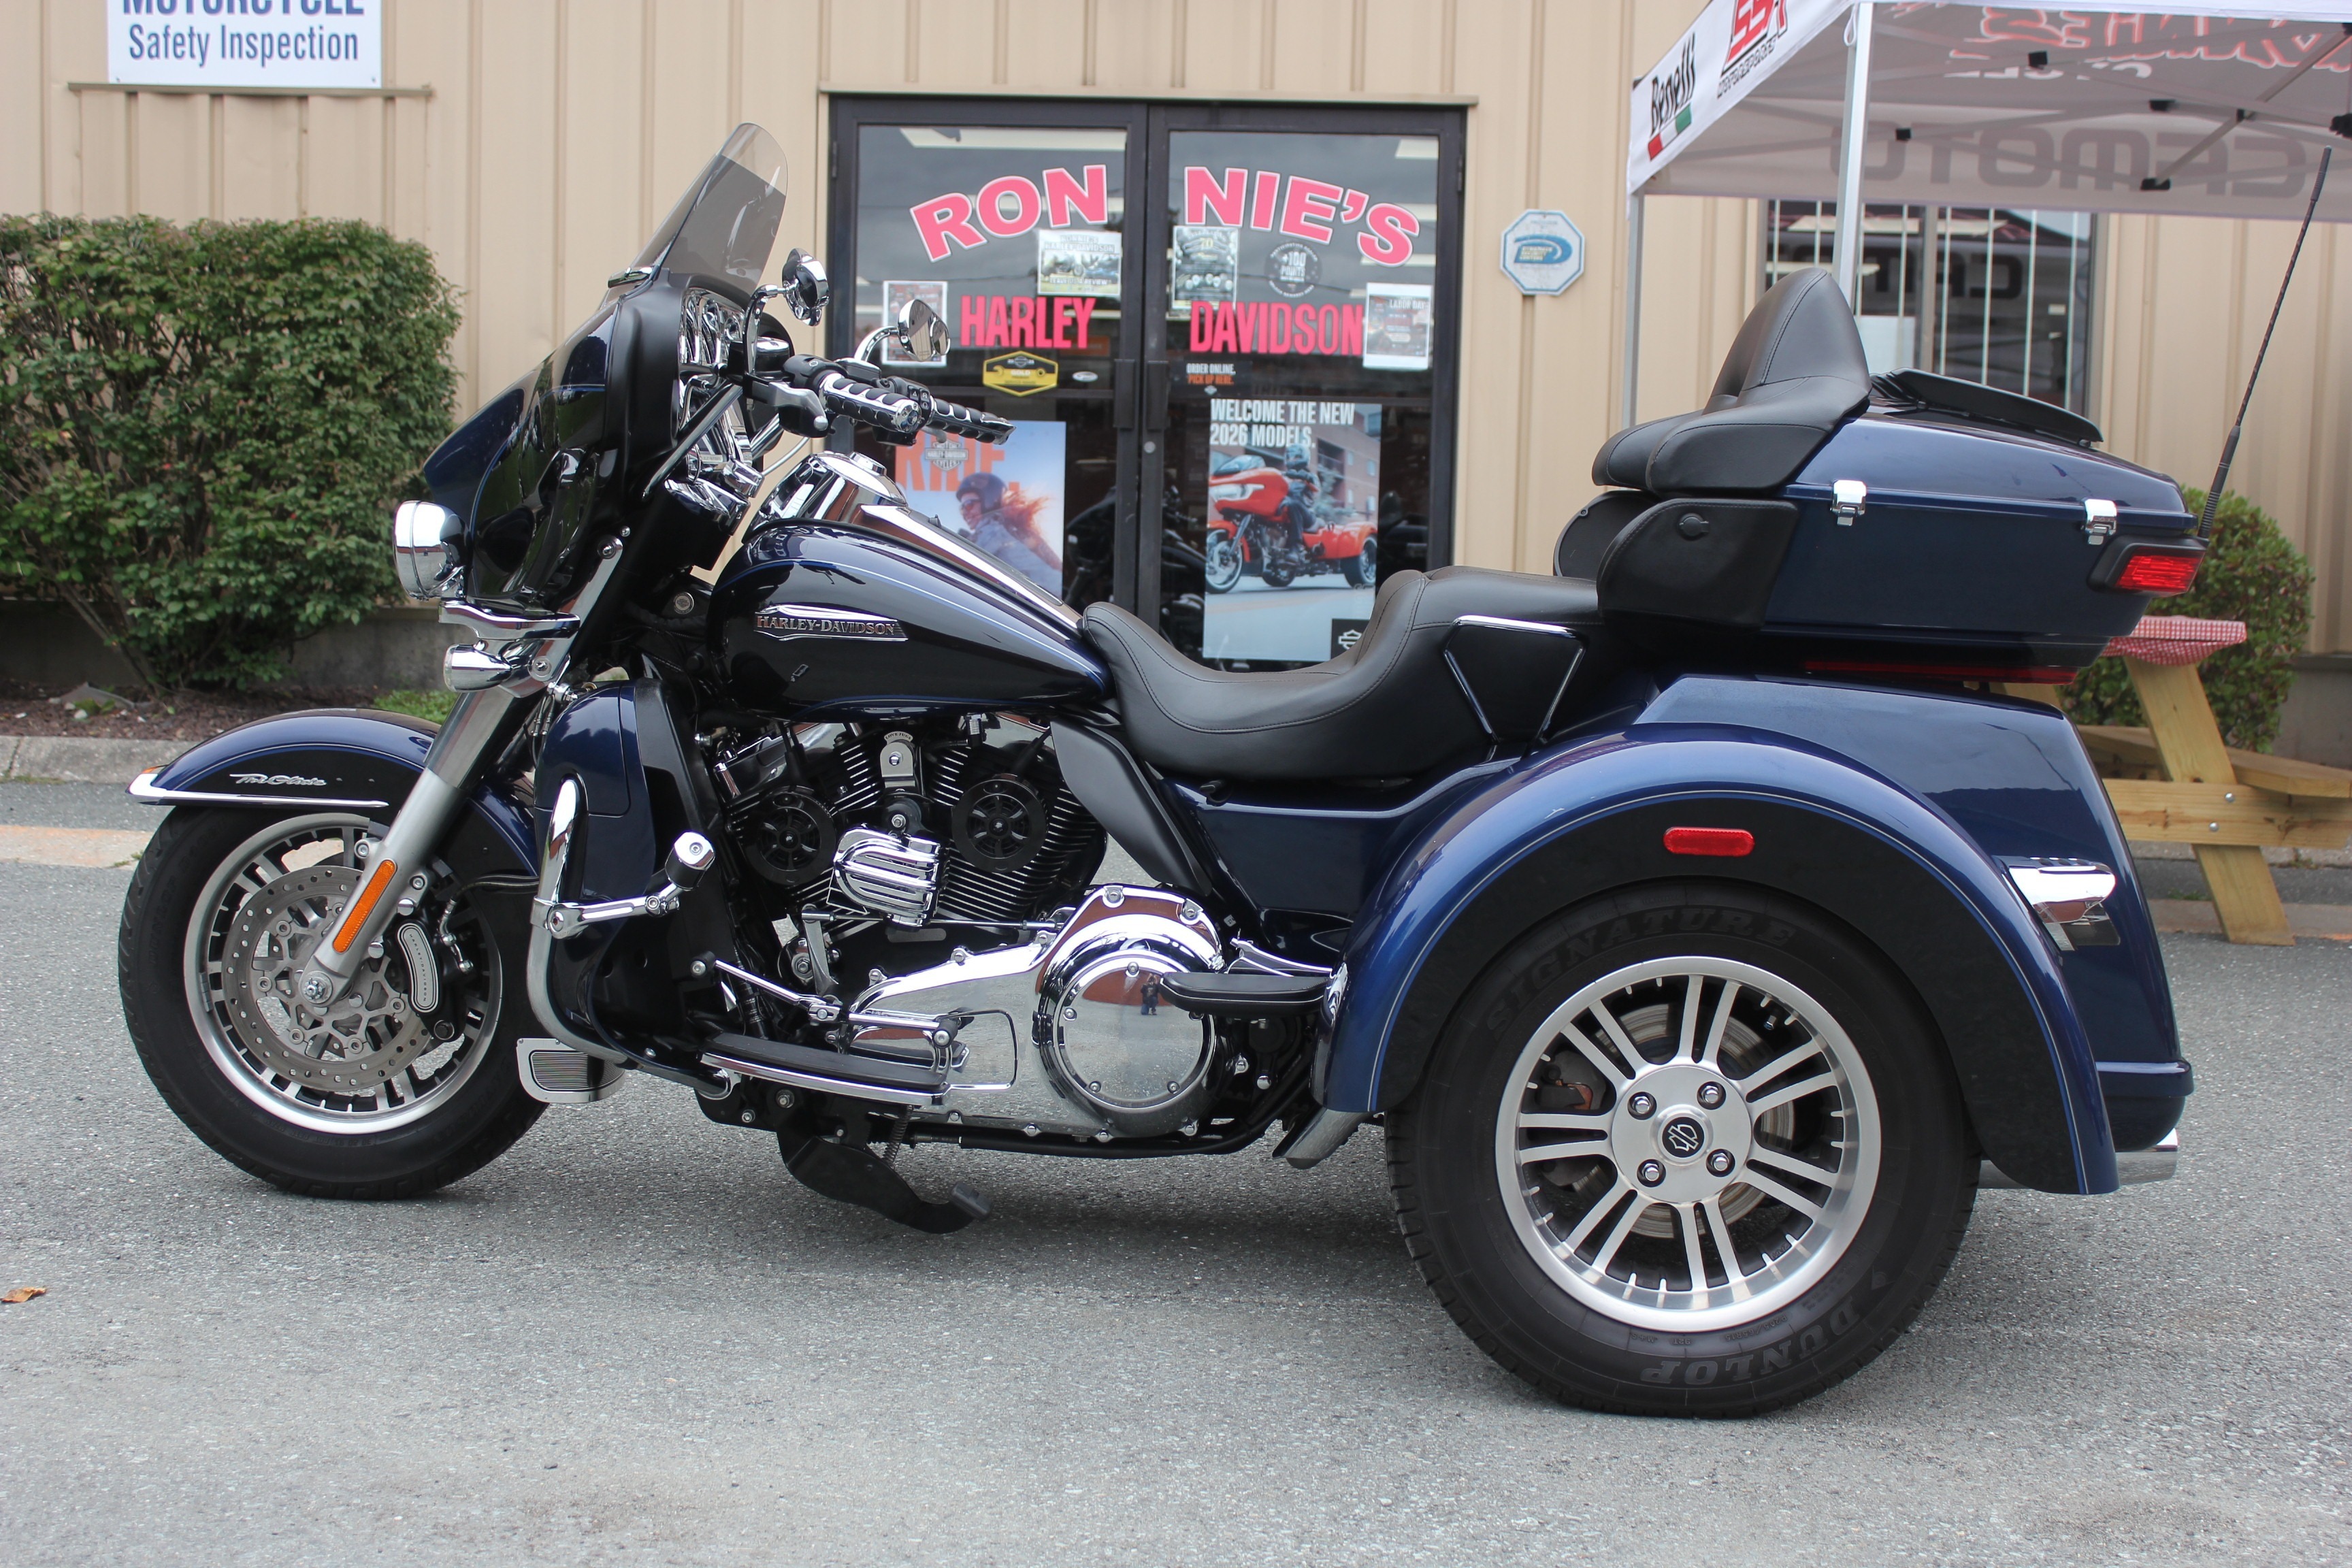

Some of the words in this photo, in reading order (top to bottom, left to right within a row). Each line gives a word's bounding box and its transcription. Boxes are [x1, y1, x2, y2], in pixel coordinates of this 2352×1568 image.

[129, 24, 210, 67] Safety
[220, 24, 359, 67] Inspection
[1650, 32, 1696, 136] Benelli
[910, 164, 1108, 262] RON
[1184, 166, 1420, 267] NIE'S
[960, 295, 1096, 348] HARLEY
[1190, 301, 1364, 356] DAVIDSON
[1186, 363, 1209, 374] ORDER
[1188, 374, 1204, 384] PICK
[1205, 375, 1215, 384] UP
[1209, 423, 1247, 446] 2026
[1251, 425, 1316, 448] MODELS.
[1211, 398, 1286, 423] WELCOME
[1288, 400, 1317, 424] THE
[1320, 402, 1355, 425] NEW
[757, 616, 895, 635] HARLEY-DAVIDSON
[410, 933, 427, 1001] HARLEY-DAVIDSON
[1486, 908, 1799, 1043] SIGNATURE
[1639, 1296, 1860, 1386] DUNLOP
